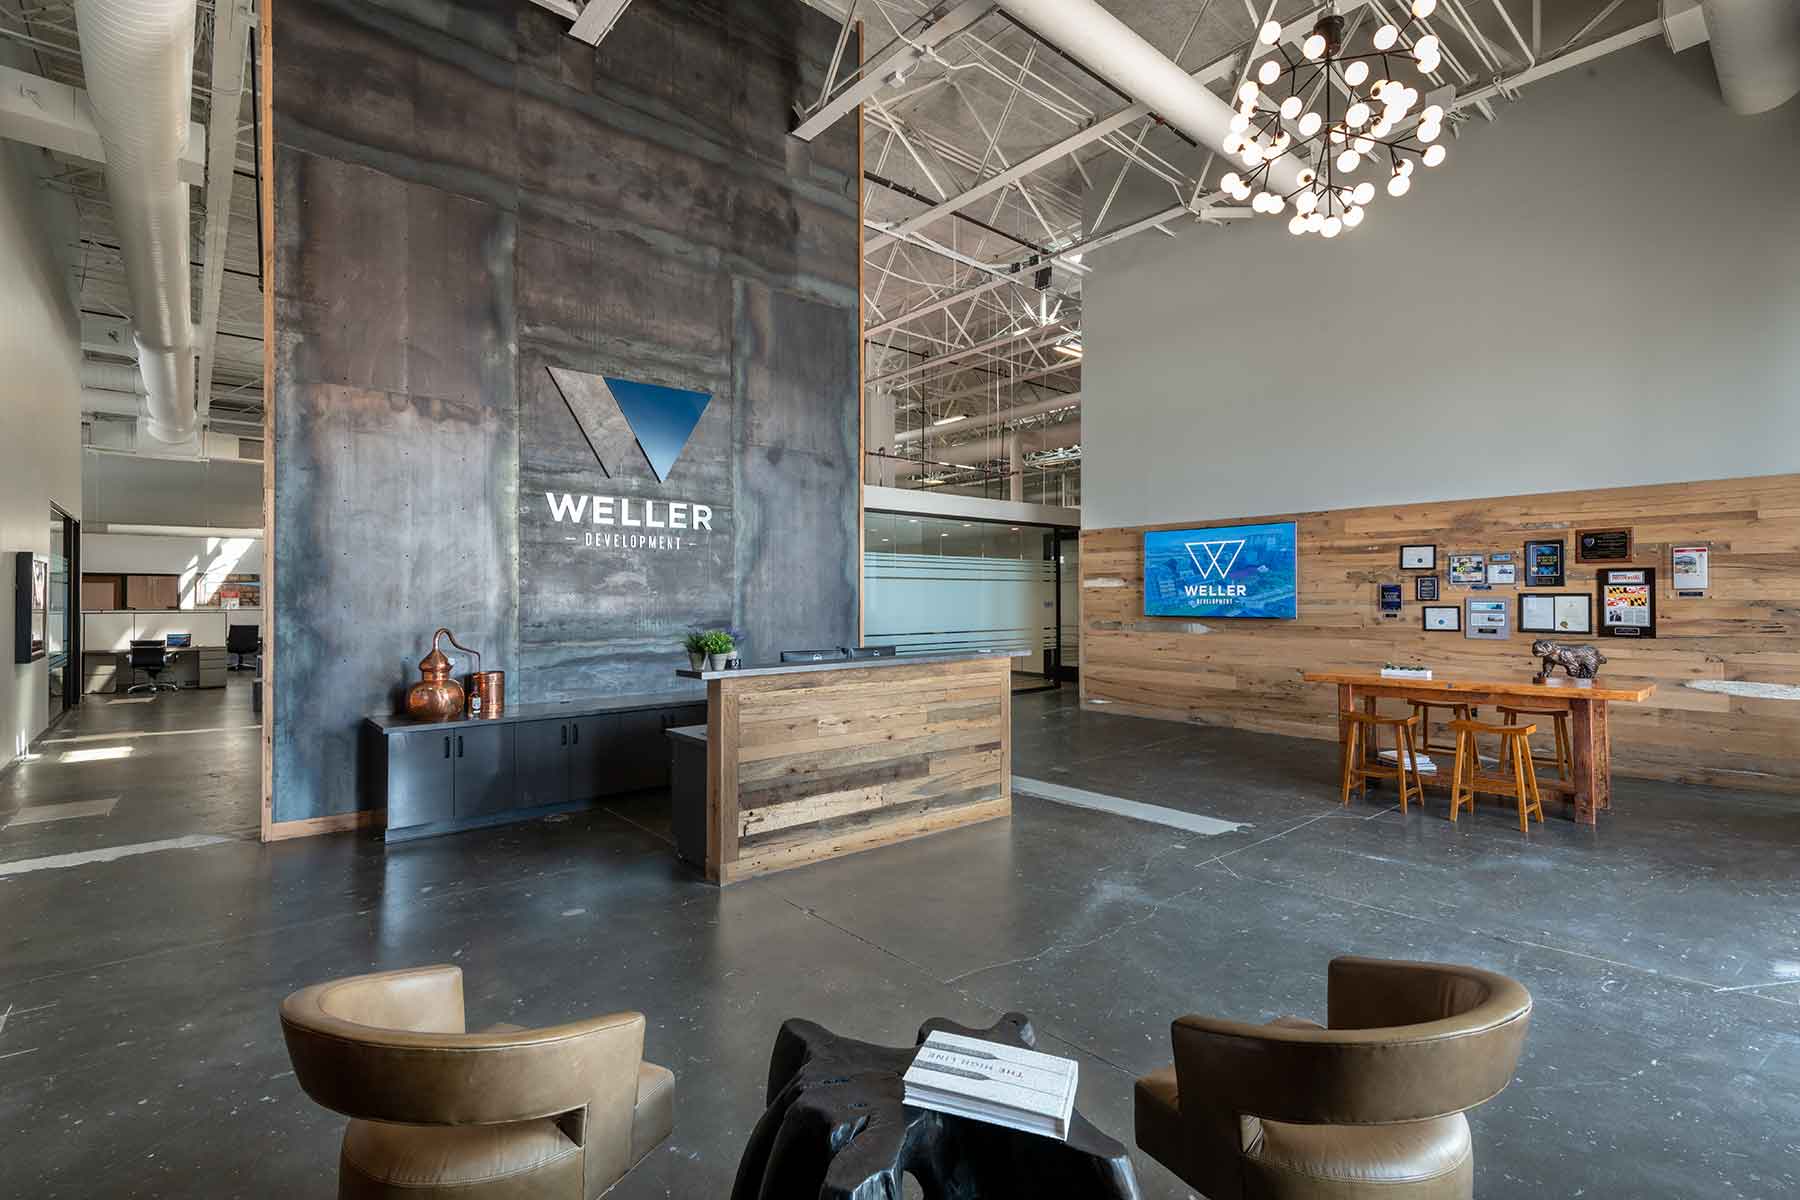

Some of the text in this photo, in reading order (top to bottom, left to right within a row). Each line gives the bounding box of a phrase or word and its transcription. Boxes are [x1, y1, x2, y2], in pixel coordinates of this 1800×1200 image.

[545, 492, 713, 531] WELLER
[585, 532, 681, 550] DEVELOPMENT
[1184, 584, 1246, 596] WELLER
[928, 1052, 1025, 1079] THE HIGH LINE
